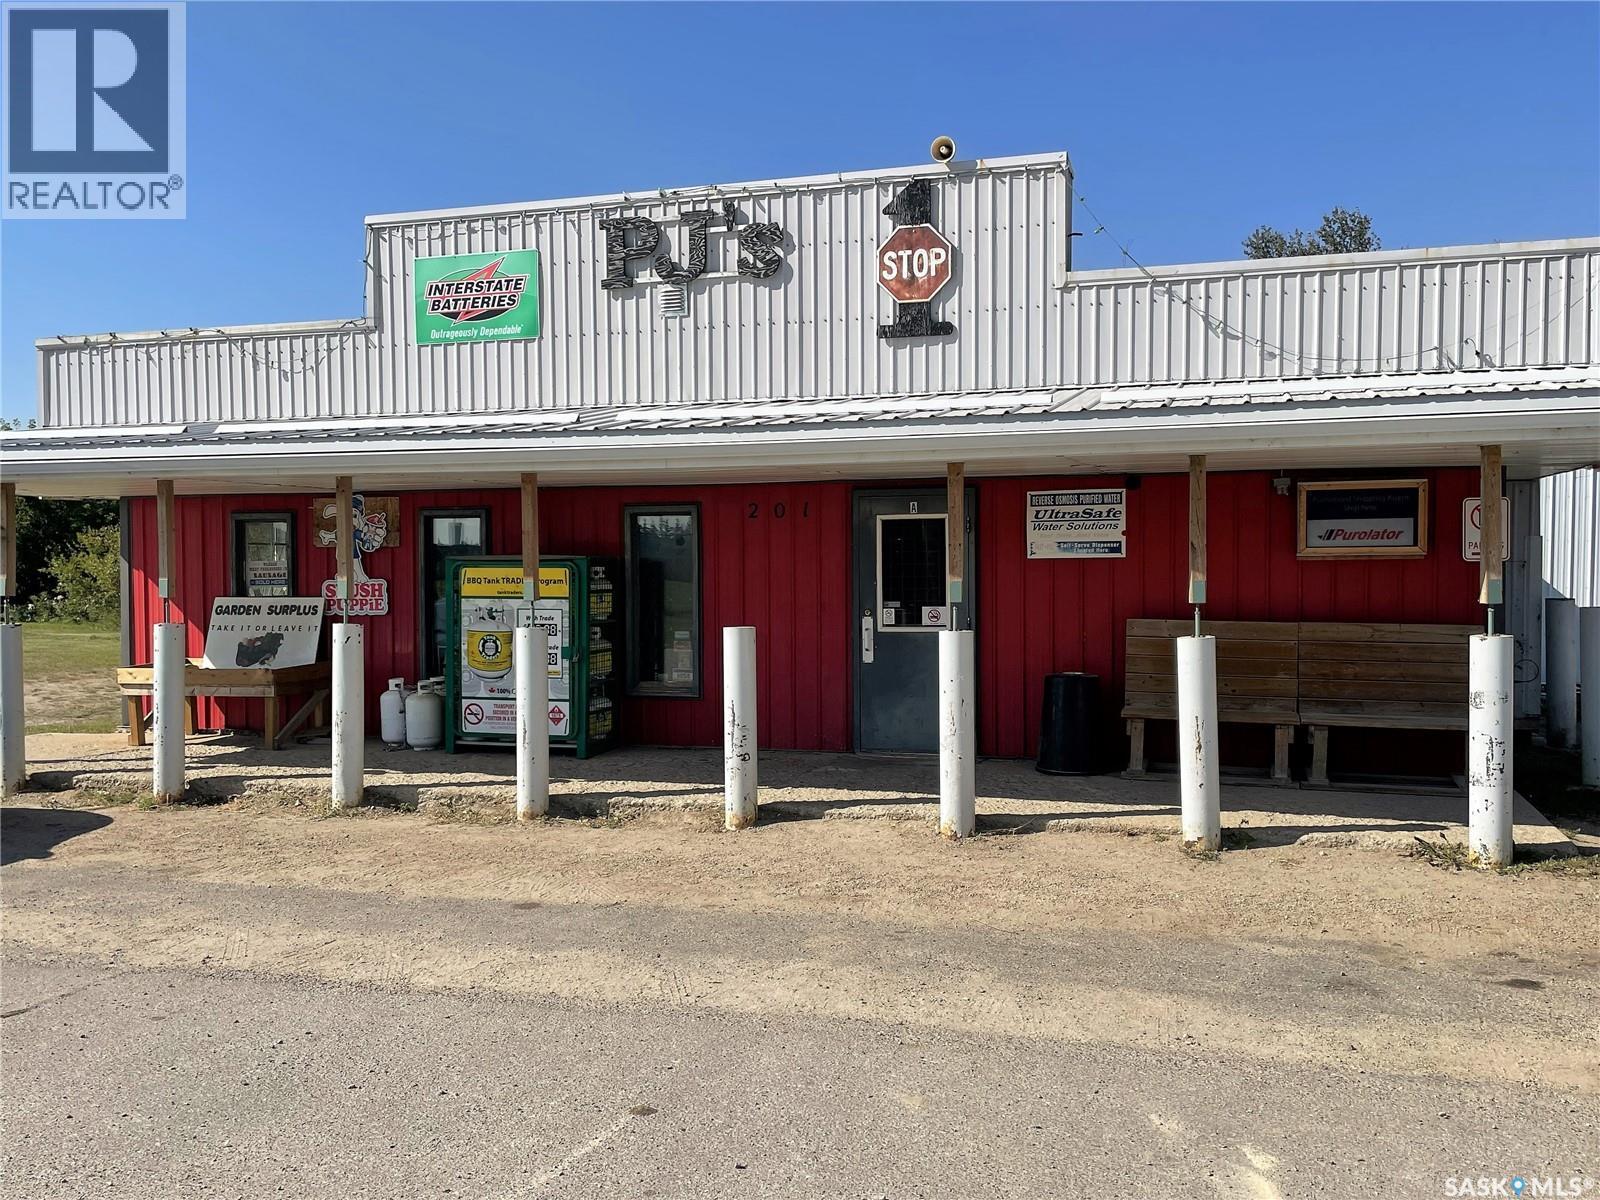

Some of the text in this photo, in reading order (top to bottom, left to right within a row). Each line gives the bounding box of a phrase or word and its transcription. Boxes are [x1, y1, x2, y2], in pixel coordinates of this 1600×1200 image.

[882, 247, 947, 281] STOP
[428, 278, 524, 296] INTERSTATE
[431, 294, 517, 312] BATTERIES
[431, 328, 478, 339] Outrageously
[1104, 492, 1121, 504] WATER
[910, 502, 917, 512] A
[1034, 507, 1122, 520] UltraSafe
[1033, 521, 1119, 531] Water Solutions
[1332, 528, 1404, 541] Purolator
[539, 578, 564, 586] ogram
[215, 605, 319, 616] GARDEN SURPLUS
